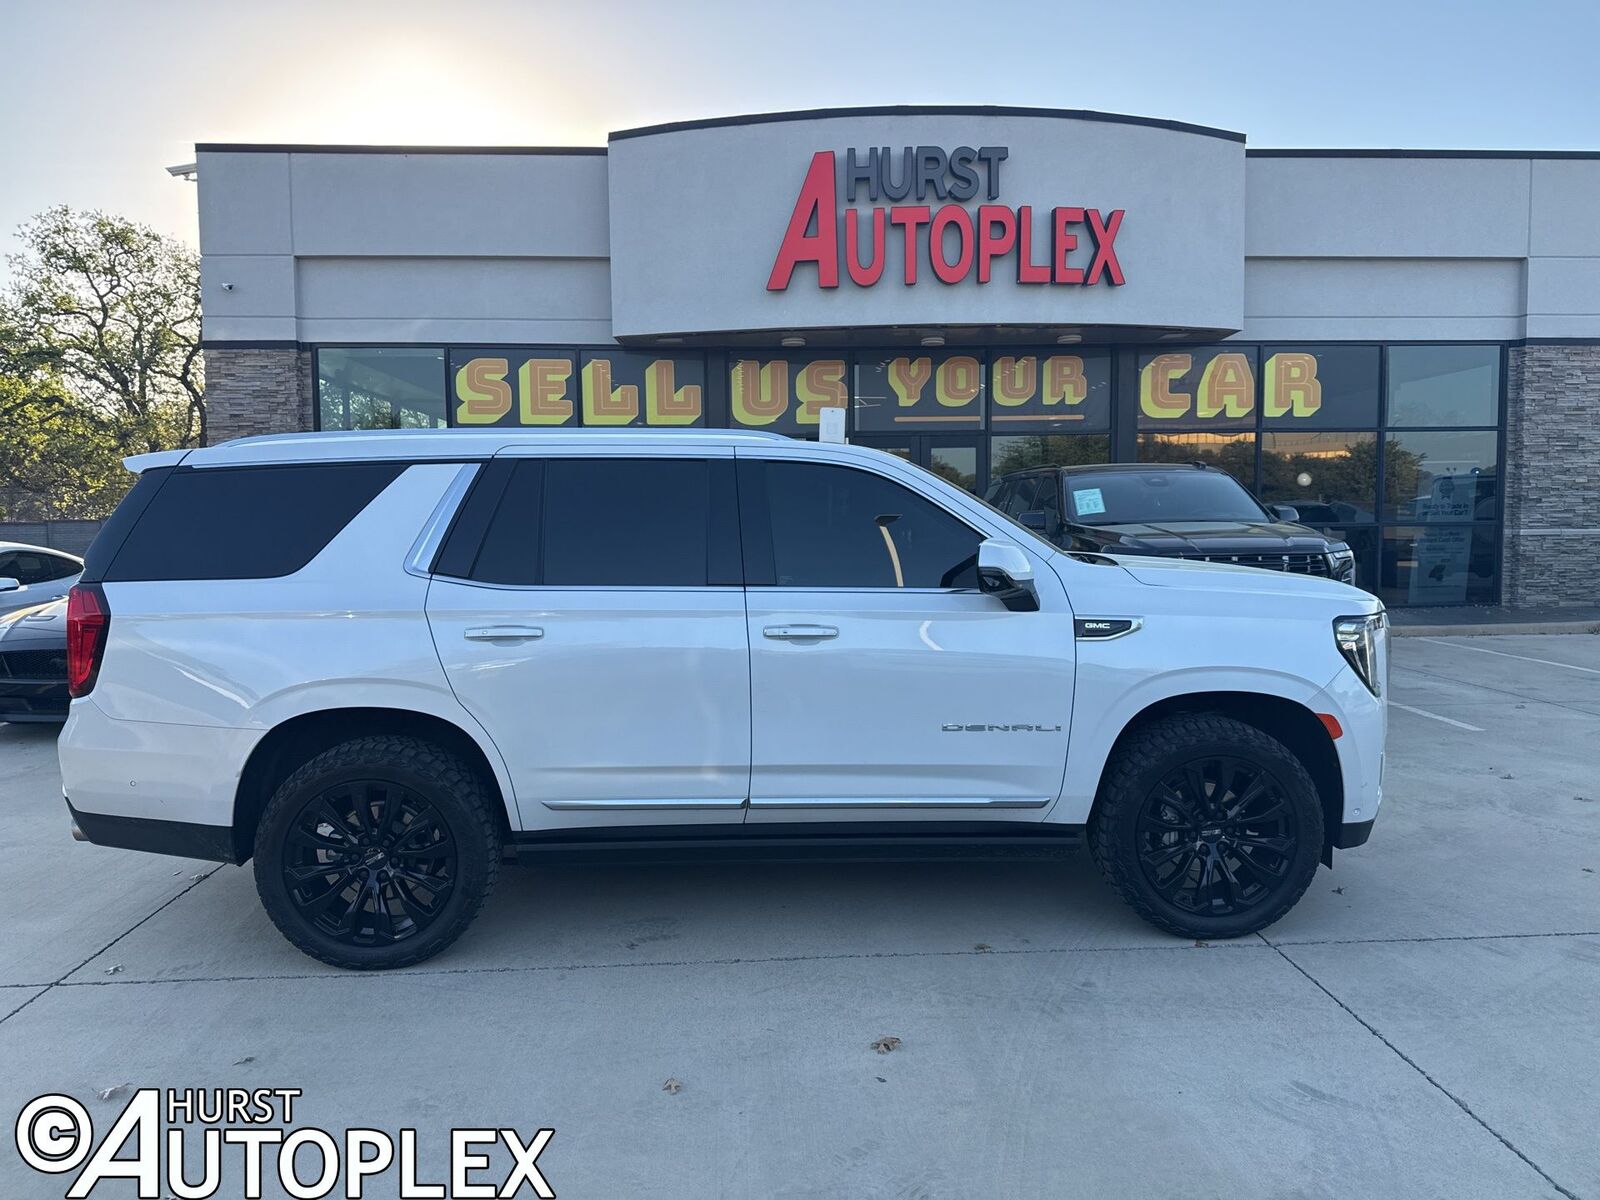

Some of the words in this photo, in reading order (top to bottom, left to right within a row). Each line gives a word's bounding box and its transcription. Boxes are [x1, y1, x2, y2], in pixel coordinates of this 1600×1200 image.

[847, 146, 1009, 201] HURST
[766, 151, 1126, 291] AUTOPLEX
[456, 357, 702, 425] SELL
[731, 358, 848, 425] US
[888, 355, 1088, 407] YOUR
[1140, 352, 1322, 419] CAR
[1084, 622, 1111, 630] GMC
[941, 723, 1062, 732] DENALI
